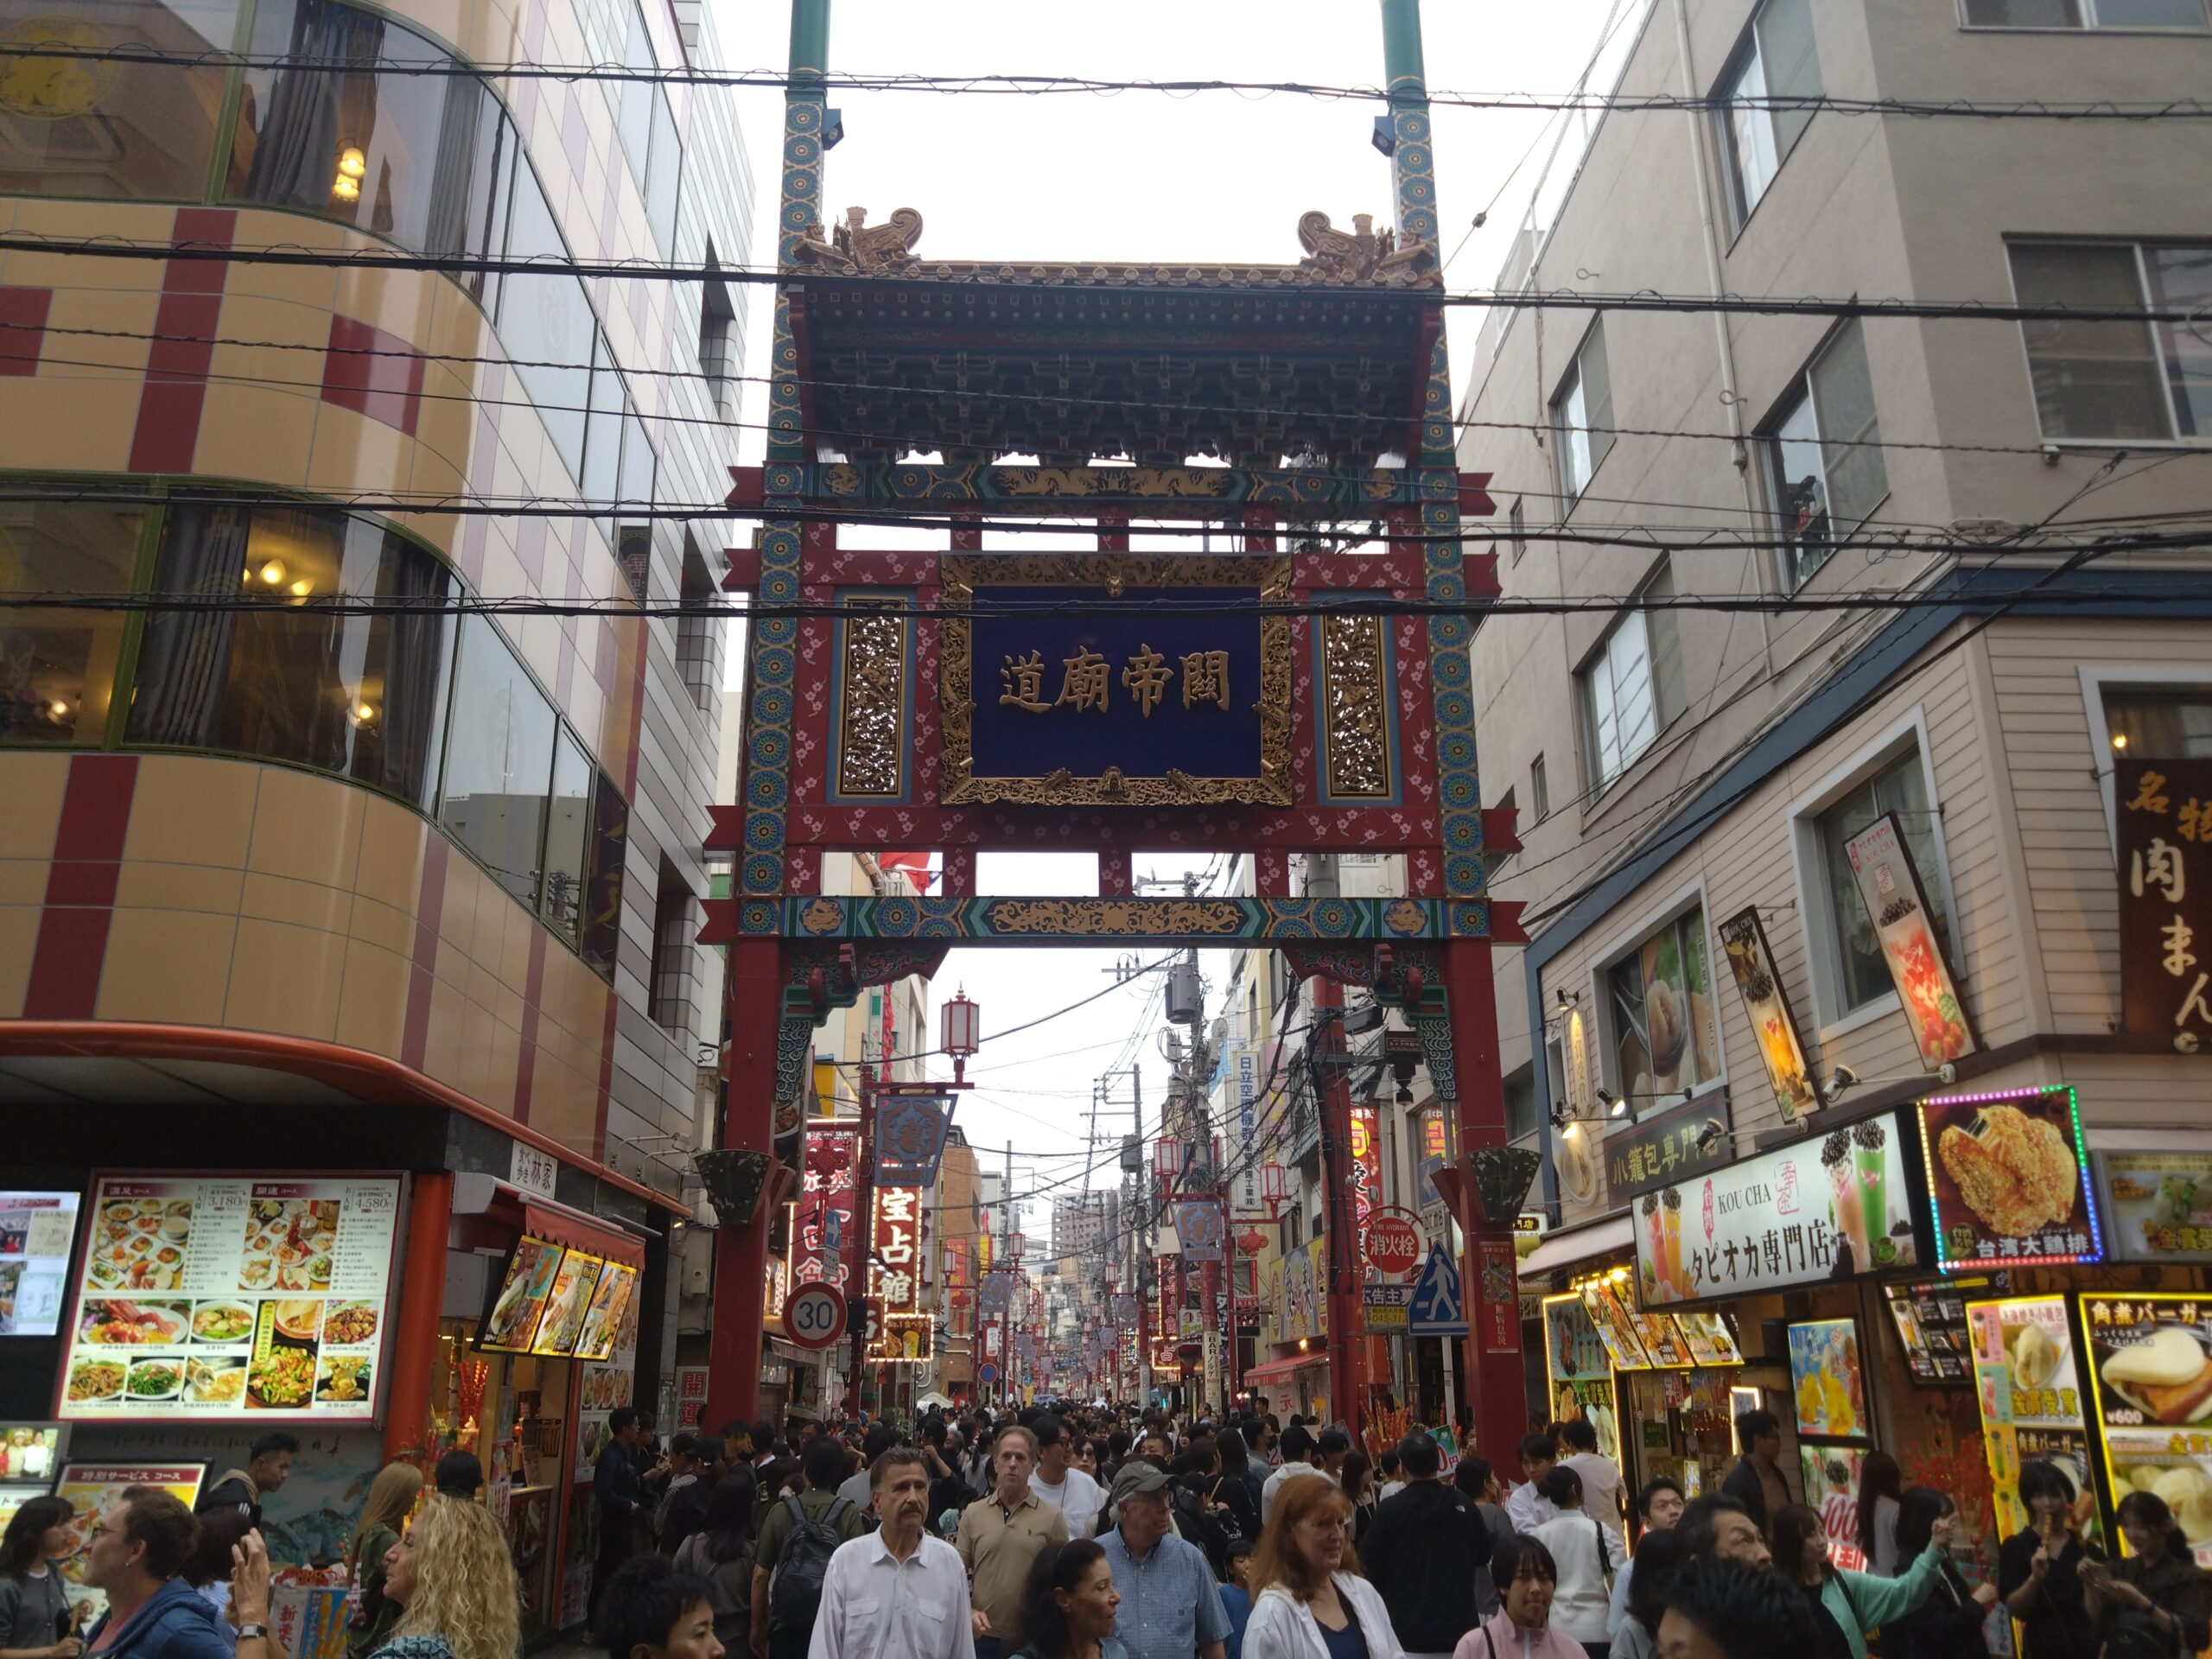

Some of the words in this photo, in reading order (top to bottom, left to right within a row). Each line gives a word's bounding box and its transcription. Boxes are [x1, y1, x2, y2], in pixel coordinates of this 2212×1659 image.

[1878, 839, 1896, 855] CHA
[1718, 1190, 1743, 1215] KOU
[1745, 1183, 1771, 1206] CHA
[878, 1187, 915, 1304] 宝占館
[1370, 1234, 1415, 1257] 消火栓
[1692, 1218, 1831, 1287] タピオカ専門店
[797, 1300, 833, 1332] 30
[679, 1371, 707, 1427] 開運
[2107, 1408, 2143, 1424] ¥600
